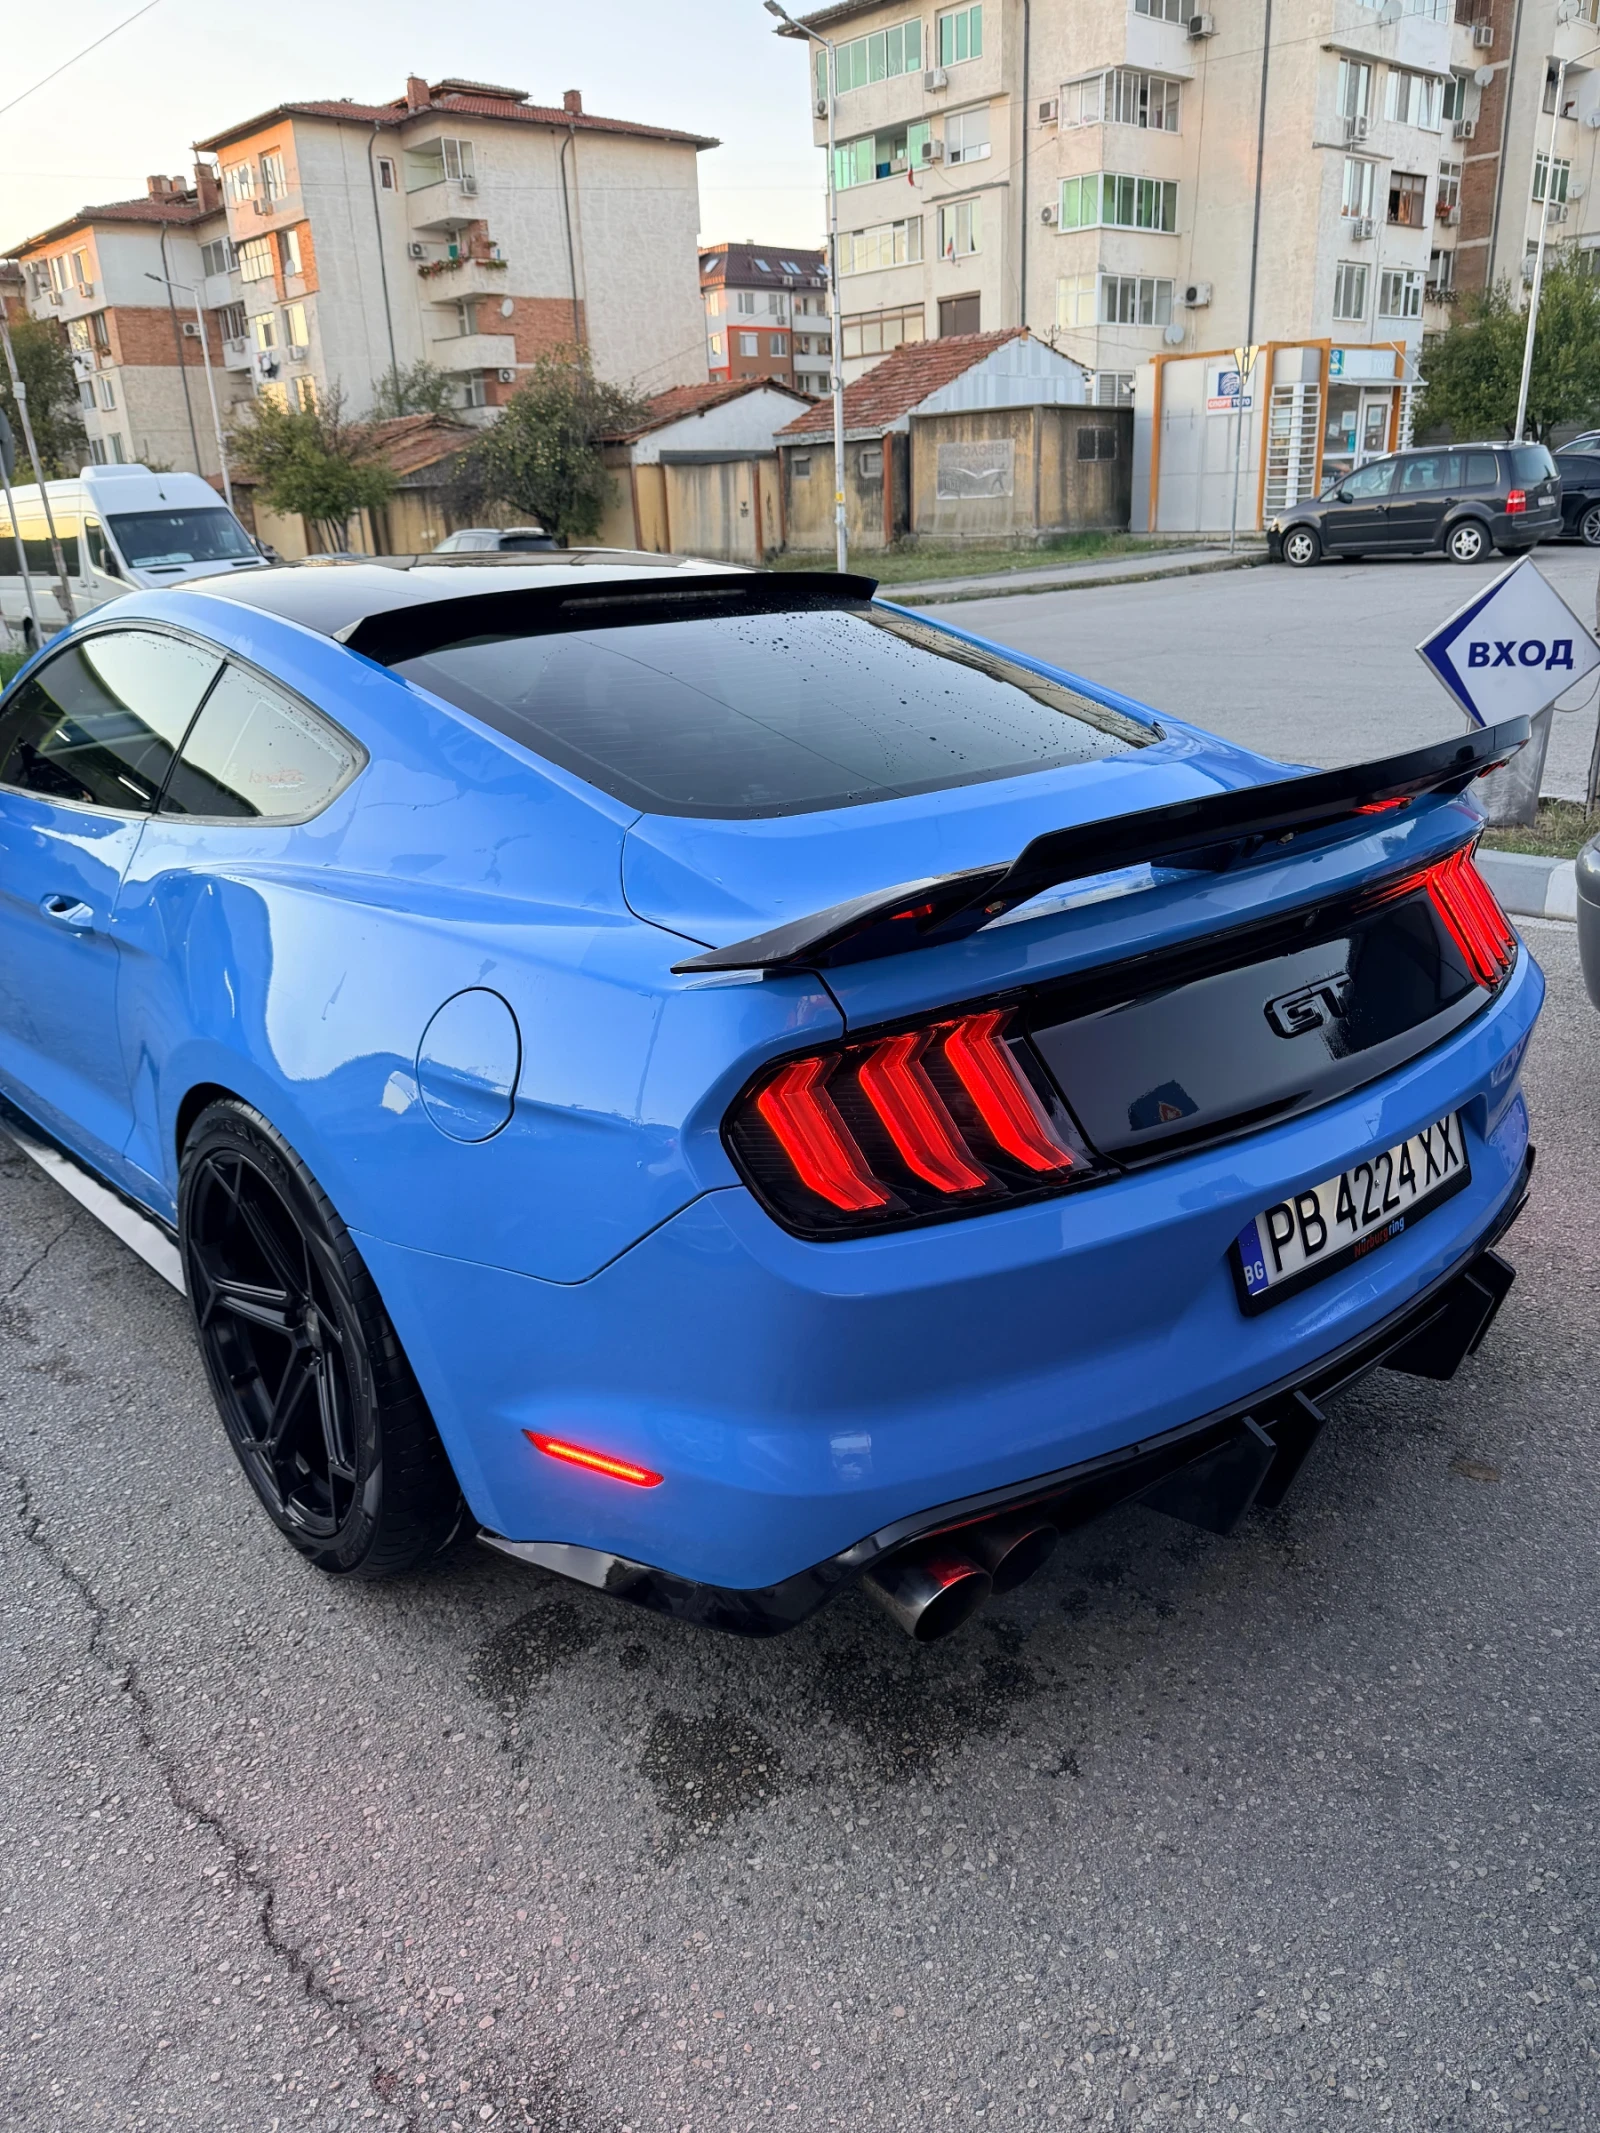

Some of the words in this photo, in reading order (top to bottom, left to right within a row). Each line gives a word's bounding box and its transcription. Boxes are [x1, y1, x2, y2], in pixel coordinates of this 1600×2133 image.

[1467, 639, 1574, 671] ВХОД
[1263, 971, 1354, 1039] GT
[1264, 1189, 1328, 1273] PB
[1335, 1141, 1417, 1233] 4224
[1418, 1115, 1459, 1187] XX
[1244, 1260, 1265, 1286] BG
